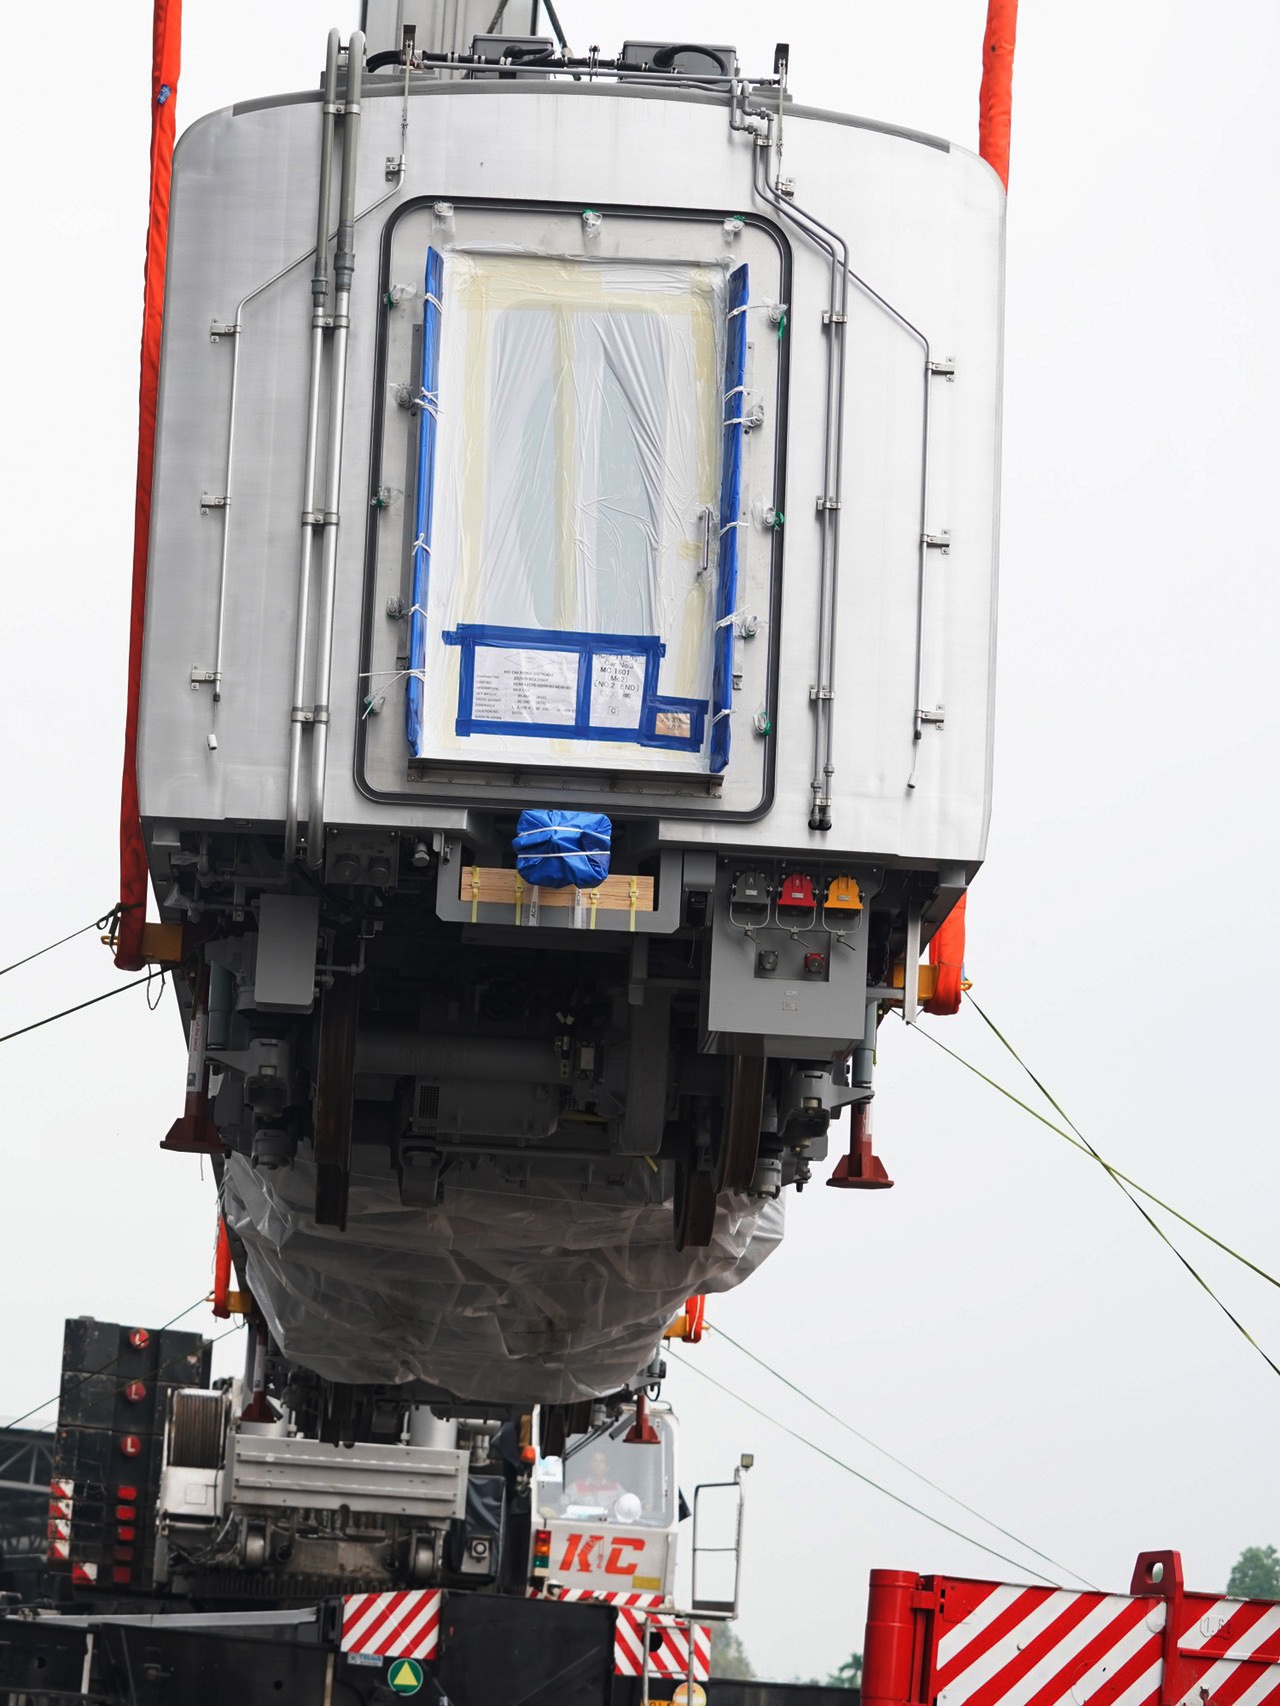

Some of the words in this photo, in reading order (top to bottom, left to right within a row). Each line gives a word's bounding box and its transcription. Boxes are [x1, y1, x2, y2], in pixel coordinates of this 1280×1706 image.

[131, 1384, 139, 1399] L
[127, 1437, 136, 1452] L
[559, 1534, 646, 1576] KC
